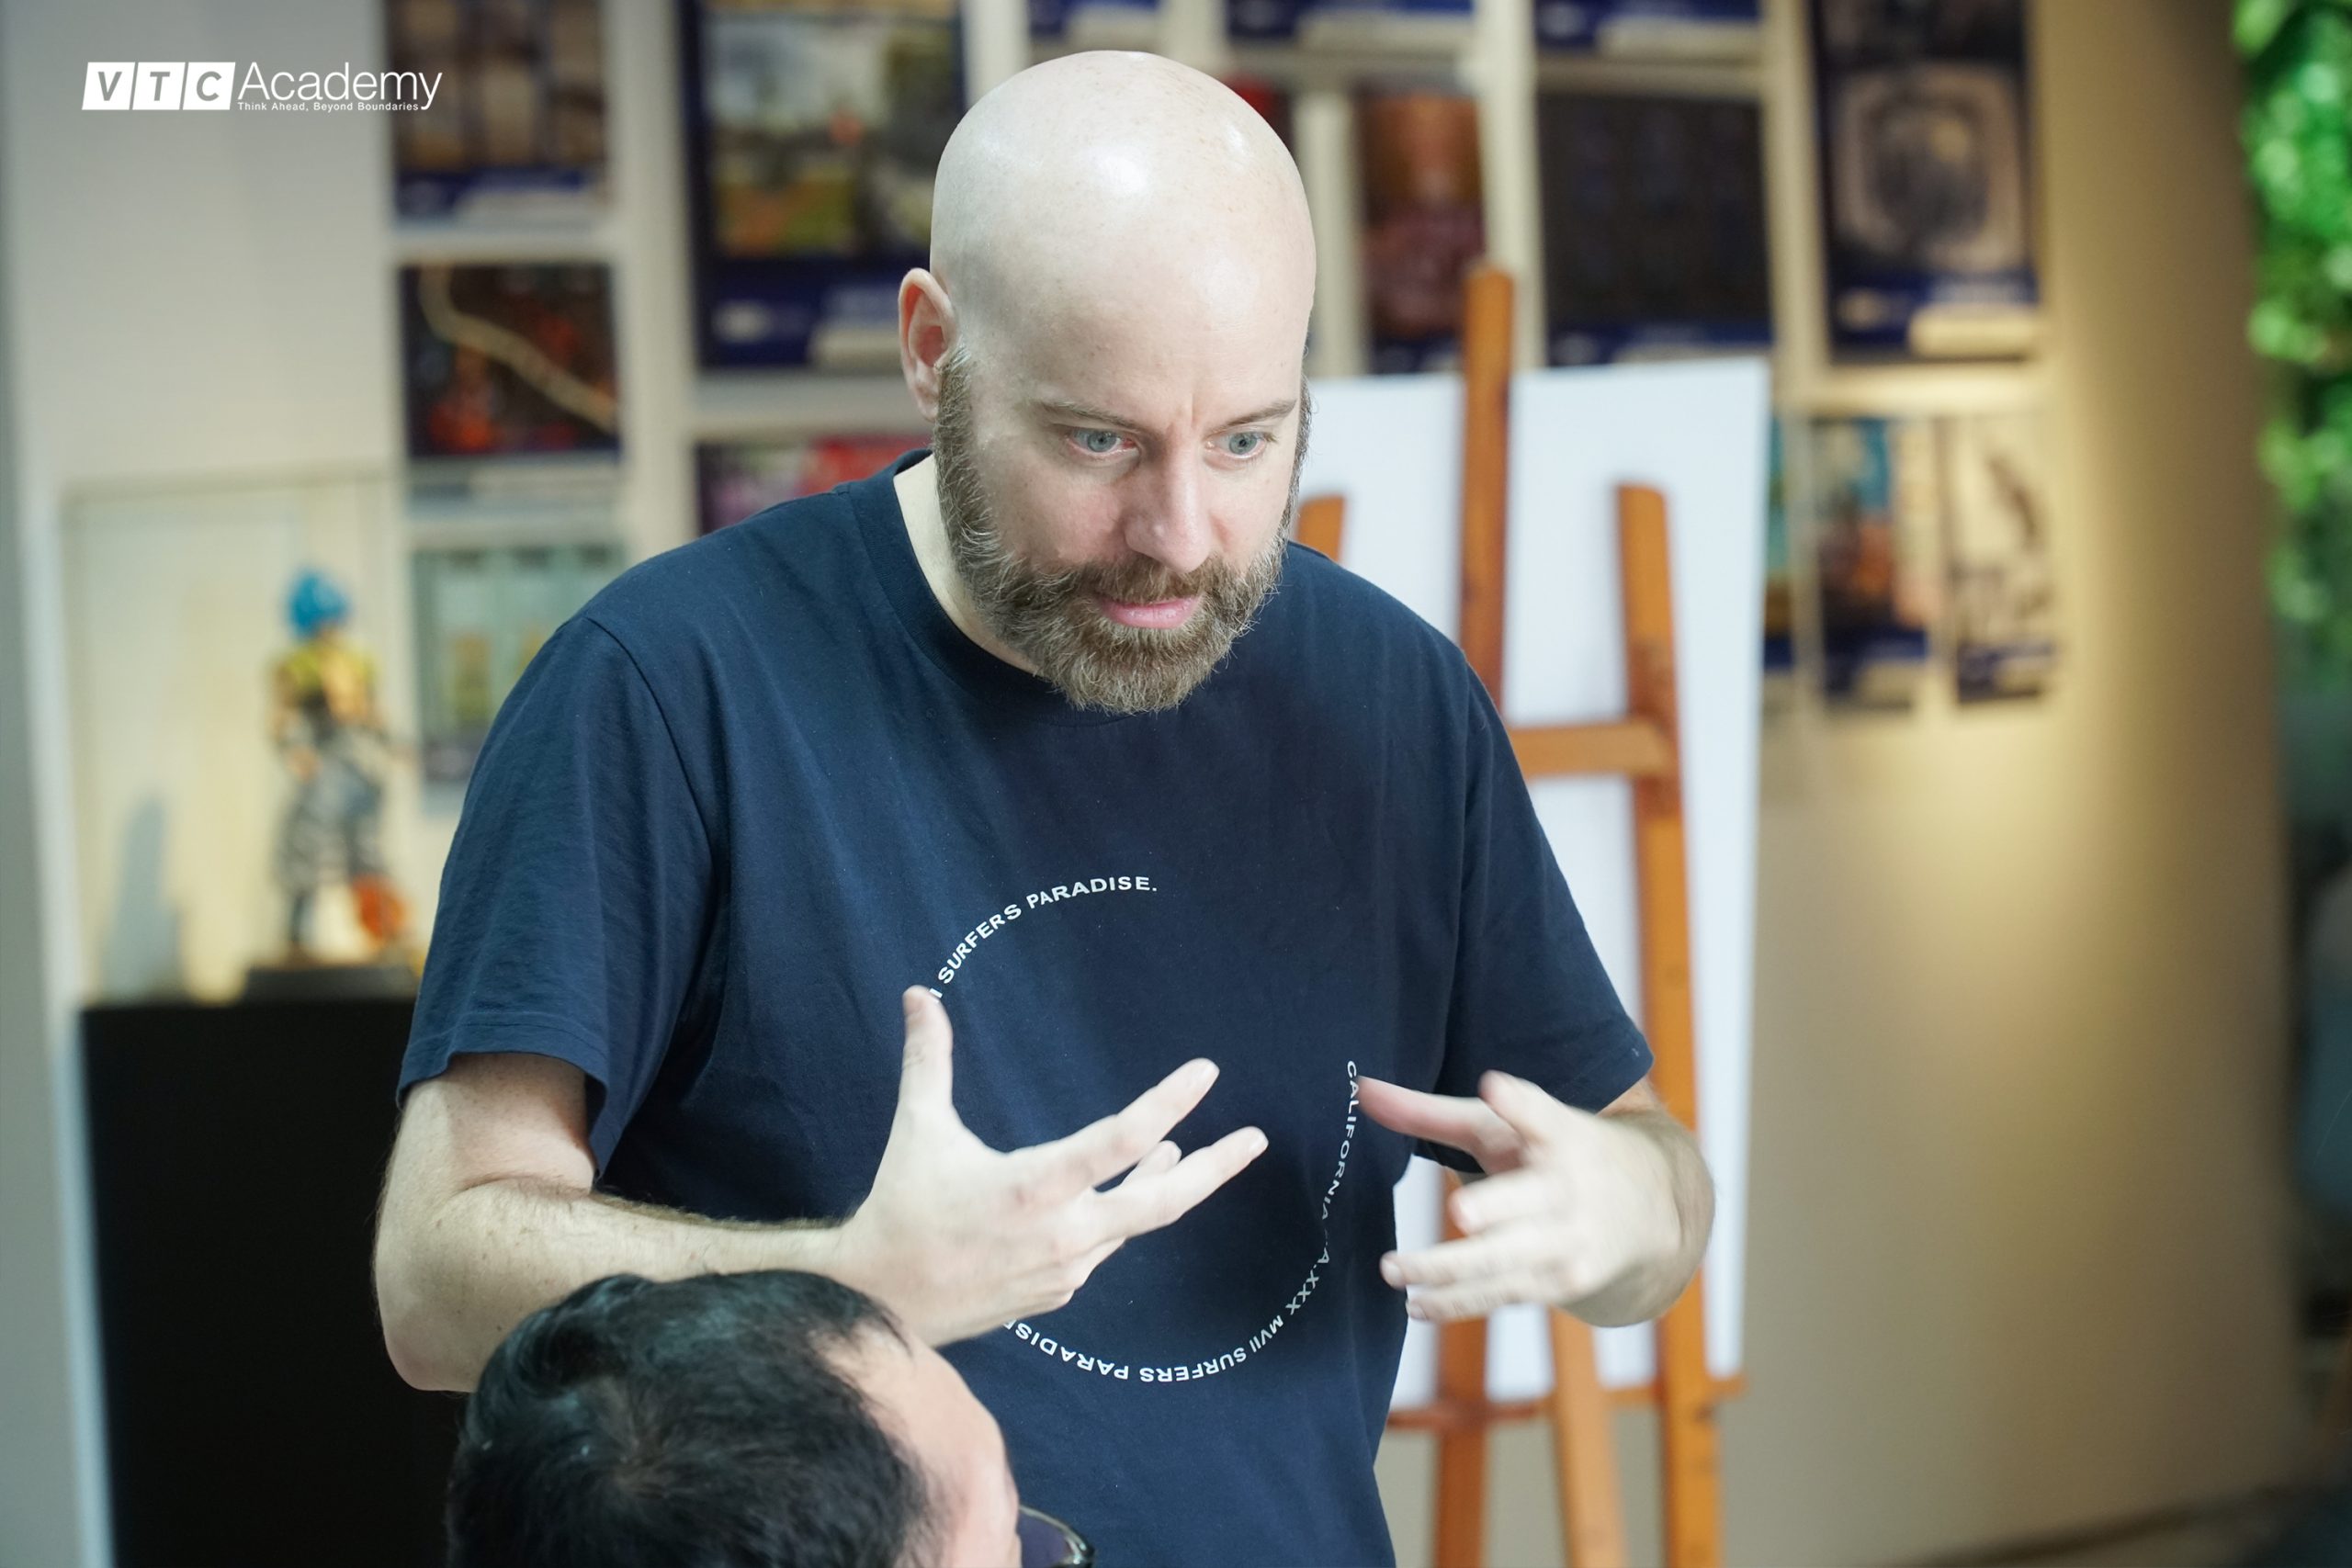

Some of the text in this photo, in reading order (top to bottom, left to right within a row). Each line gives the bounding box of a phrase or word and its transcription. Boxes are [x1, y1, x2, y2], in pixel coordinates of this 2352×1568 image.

[938, 876, 1158, 984] SURFERS PARADISE.
[1321, 1060, 1360, 1220] CALIFORNIA
[1139, 1347, 1247, 1382] SURFERS
[1249, 1315, 1284, 1353] MVII
